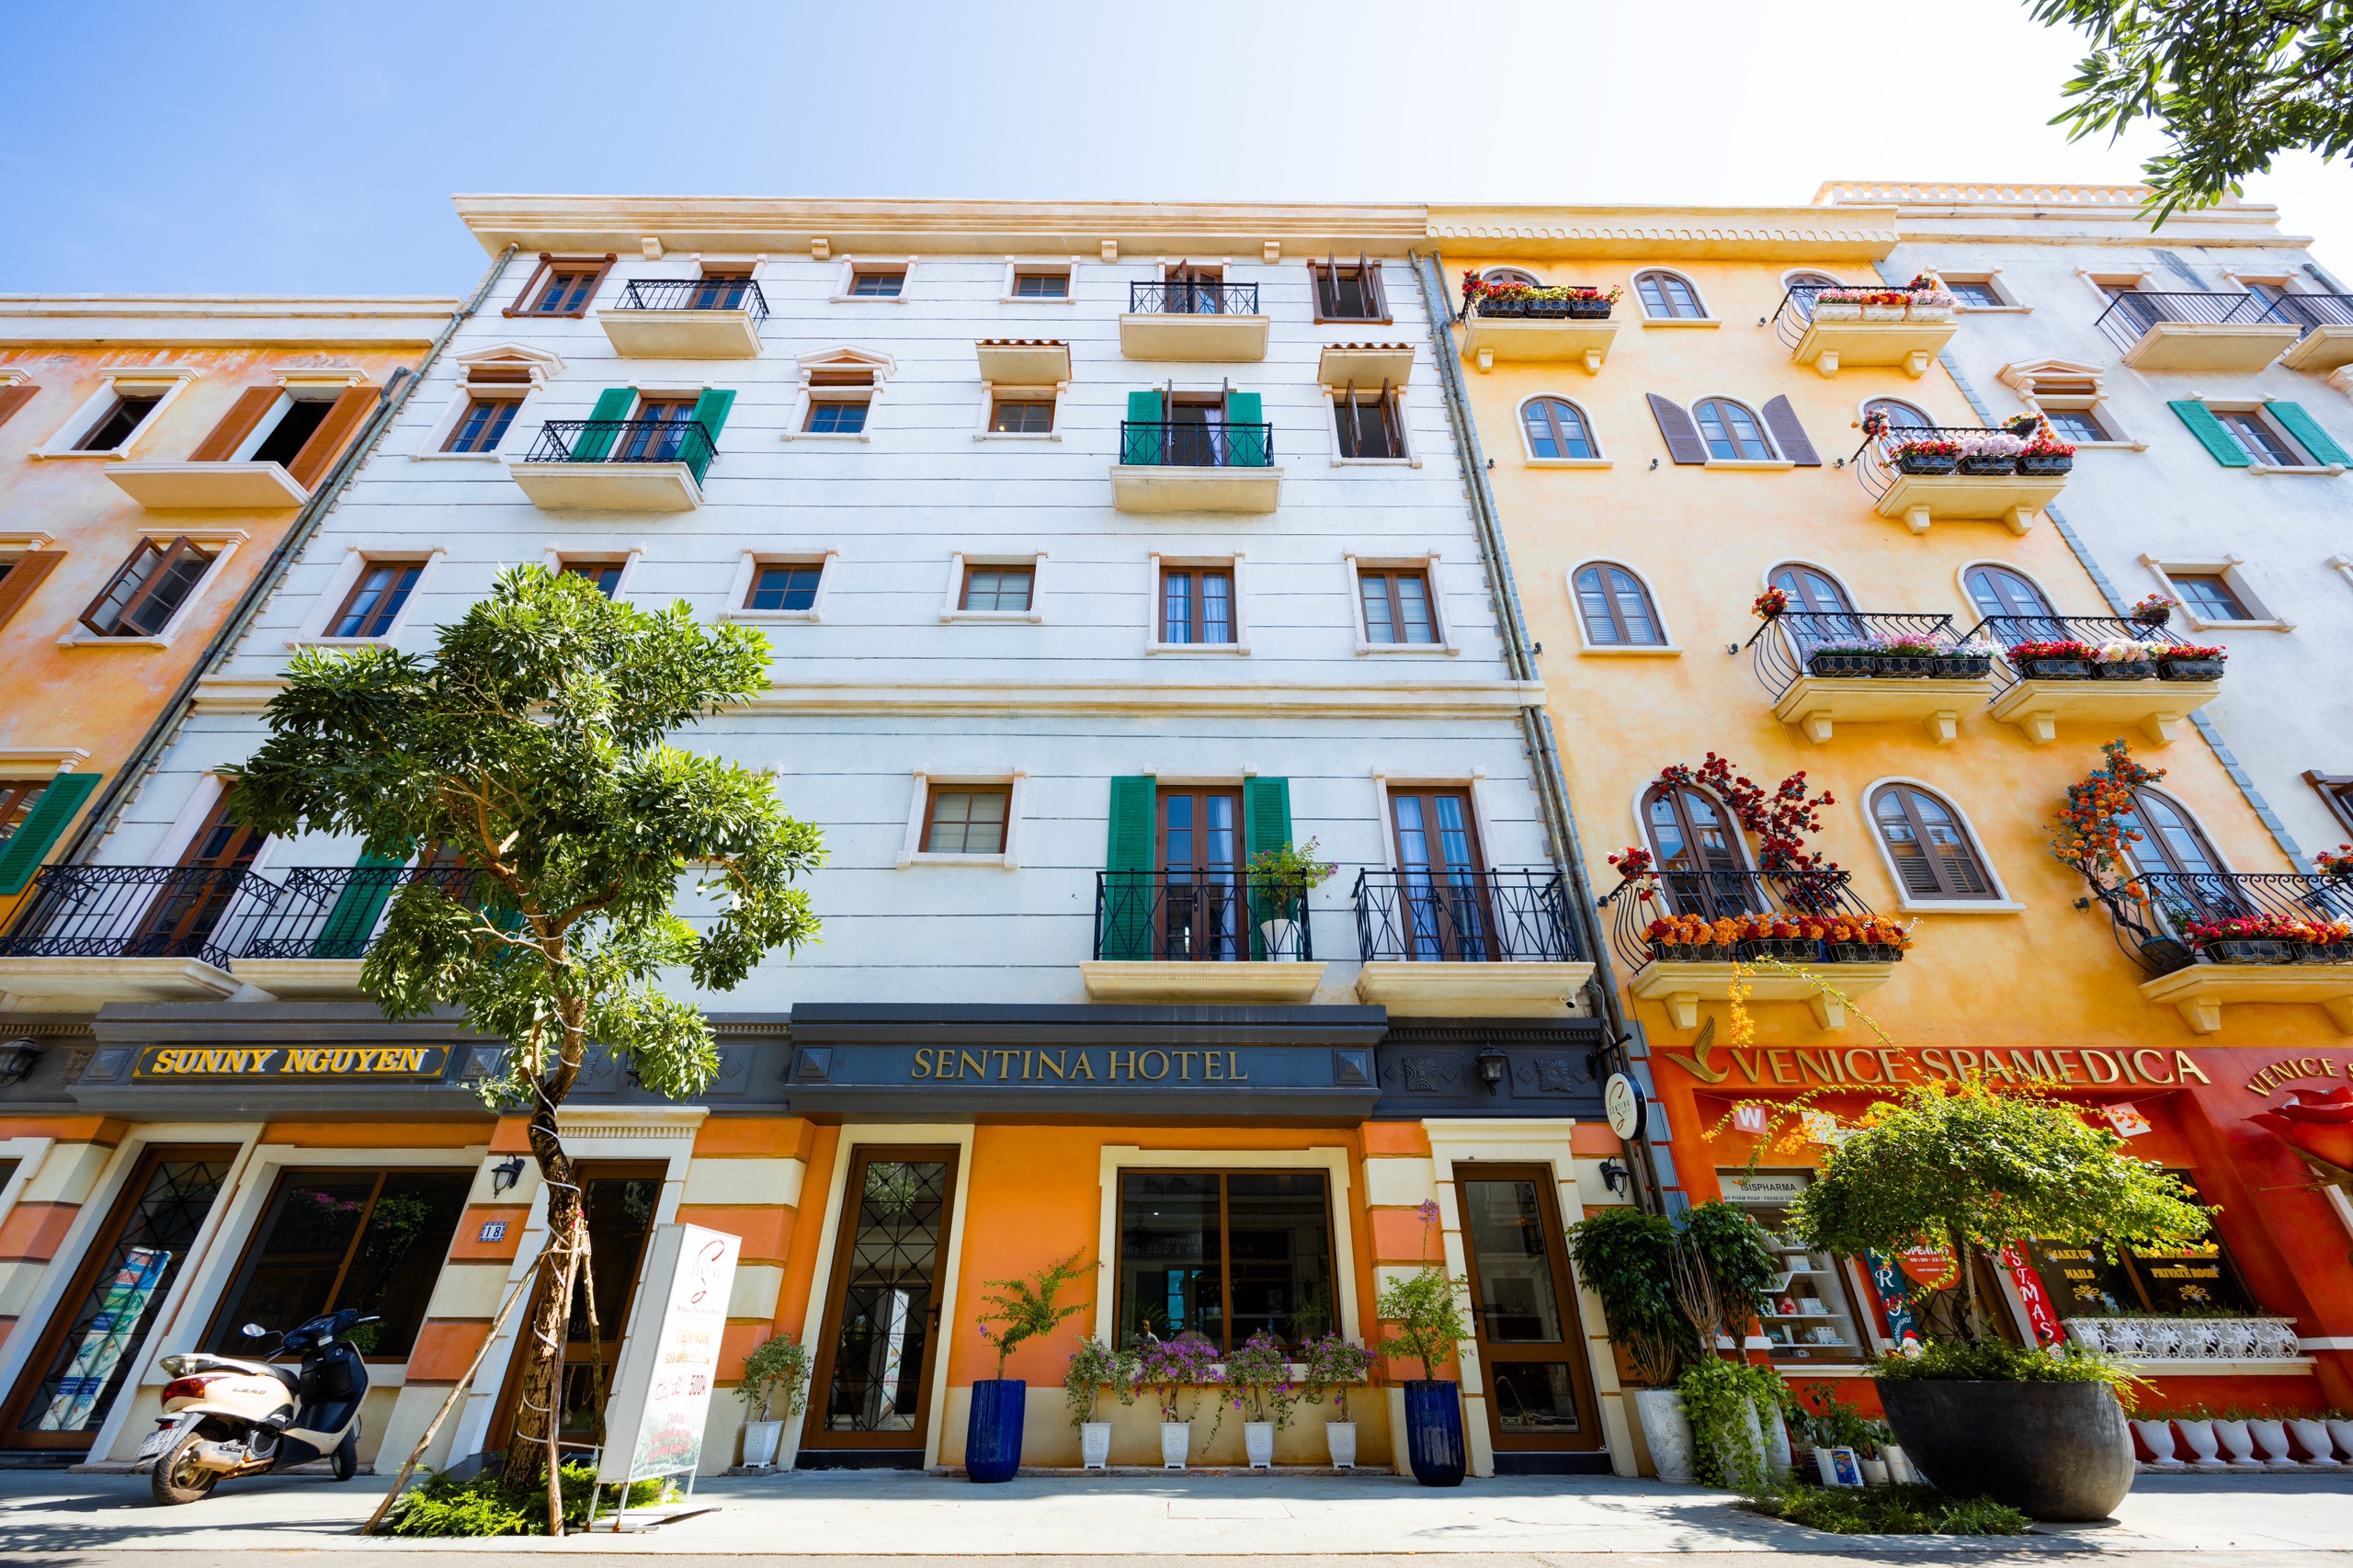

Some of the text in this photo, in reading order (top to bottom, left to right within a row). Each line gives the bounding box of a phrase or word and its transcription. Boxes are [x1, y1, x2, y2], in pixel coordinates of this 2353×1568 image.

[152, 1048, 429, 1074] SUNNY NGUYEN
[911, 1048, 1248, 1080] SENTINA HOTEL
[1731, 1049, 1911, 1084] VENICE
[2246, 1057, 2341, 1096] VENICE
[1608, 1099, 1630, 1116] SENTINA
[1737, 1106, 1762, 1130] W
[1741, 1183, 1797, 1191] ISISPHARMA
[485, 1226, 502, 1238] 18
[2063, 1268, 2096, 1279] NAILS
[2150, 1267, 2220, 1278] PRIVATE ROOM
